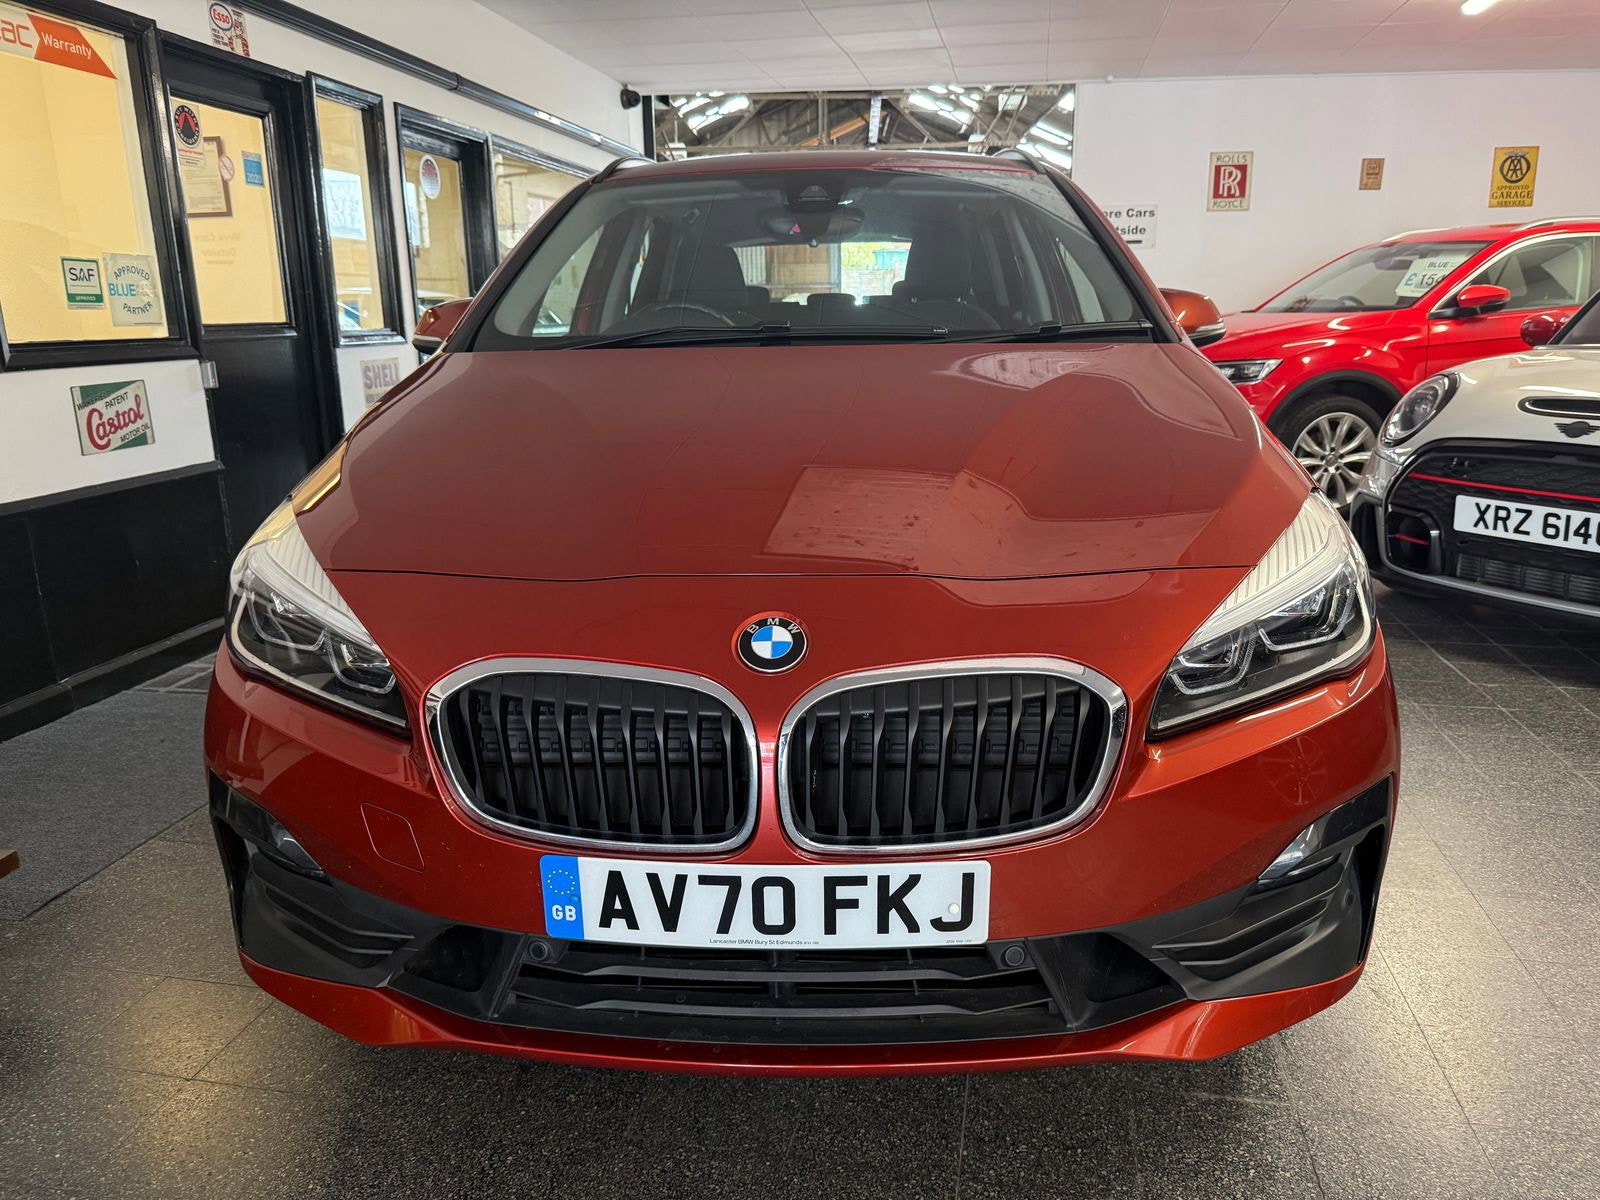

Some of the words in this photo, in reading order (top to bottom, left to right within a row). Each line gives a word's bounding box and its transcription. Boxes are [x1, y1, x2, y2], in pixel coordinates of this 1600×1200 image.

[41, 31, 92, 60] Warranty
[1216, 154, 1248, 163] ROLLS
[1212, 199, 1245, 208] ROYCE
[1491, 191, 1534, 200] GARAGE
[1103, 211, 1122, 219] ore
[1126, 208, 1155, 218] Cars
[68, 266, 95, 282] SAF
[113, 265, 151, 281] APPROVED
[108, 283, 136, 297] BLUE
[122, 301, 152, 315] PARTNER
[105, 391, 128, 410] PATENT
[86, 393, 144, 451] Castrol
[120, 427, 141, 443] MOTOR
[141, 422, 151, 434] OIL
[1472, 502, 1533, 536] XRZ
[1542, 512, 1600, 547] 614
[746, 617, 801, 634] BMW
[598, 870, 796, 936] AV70
[823, 872, 975, 936] FKJ
[551, 904, 577, 922] GB
